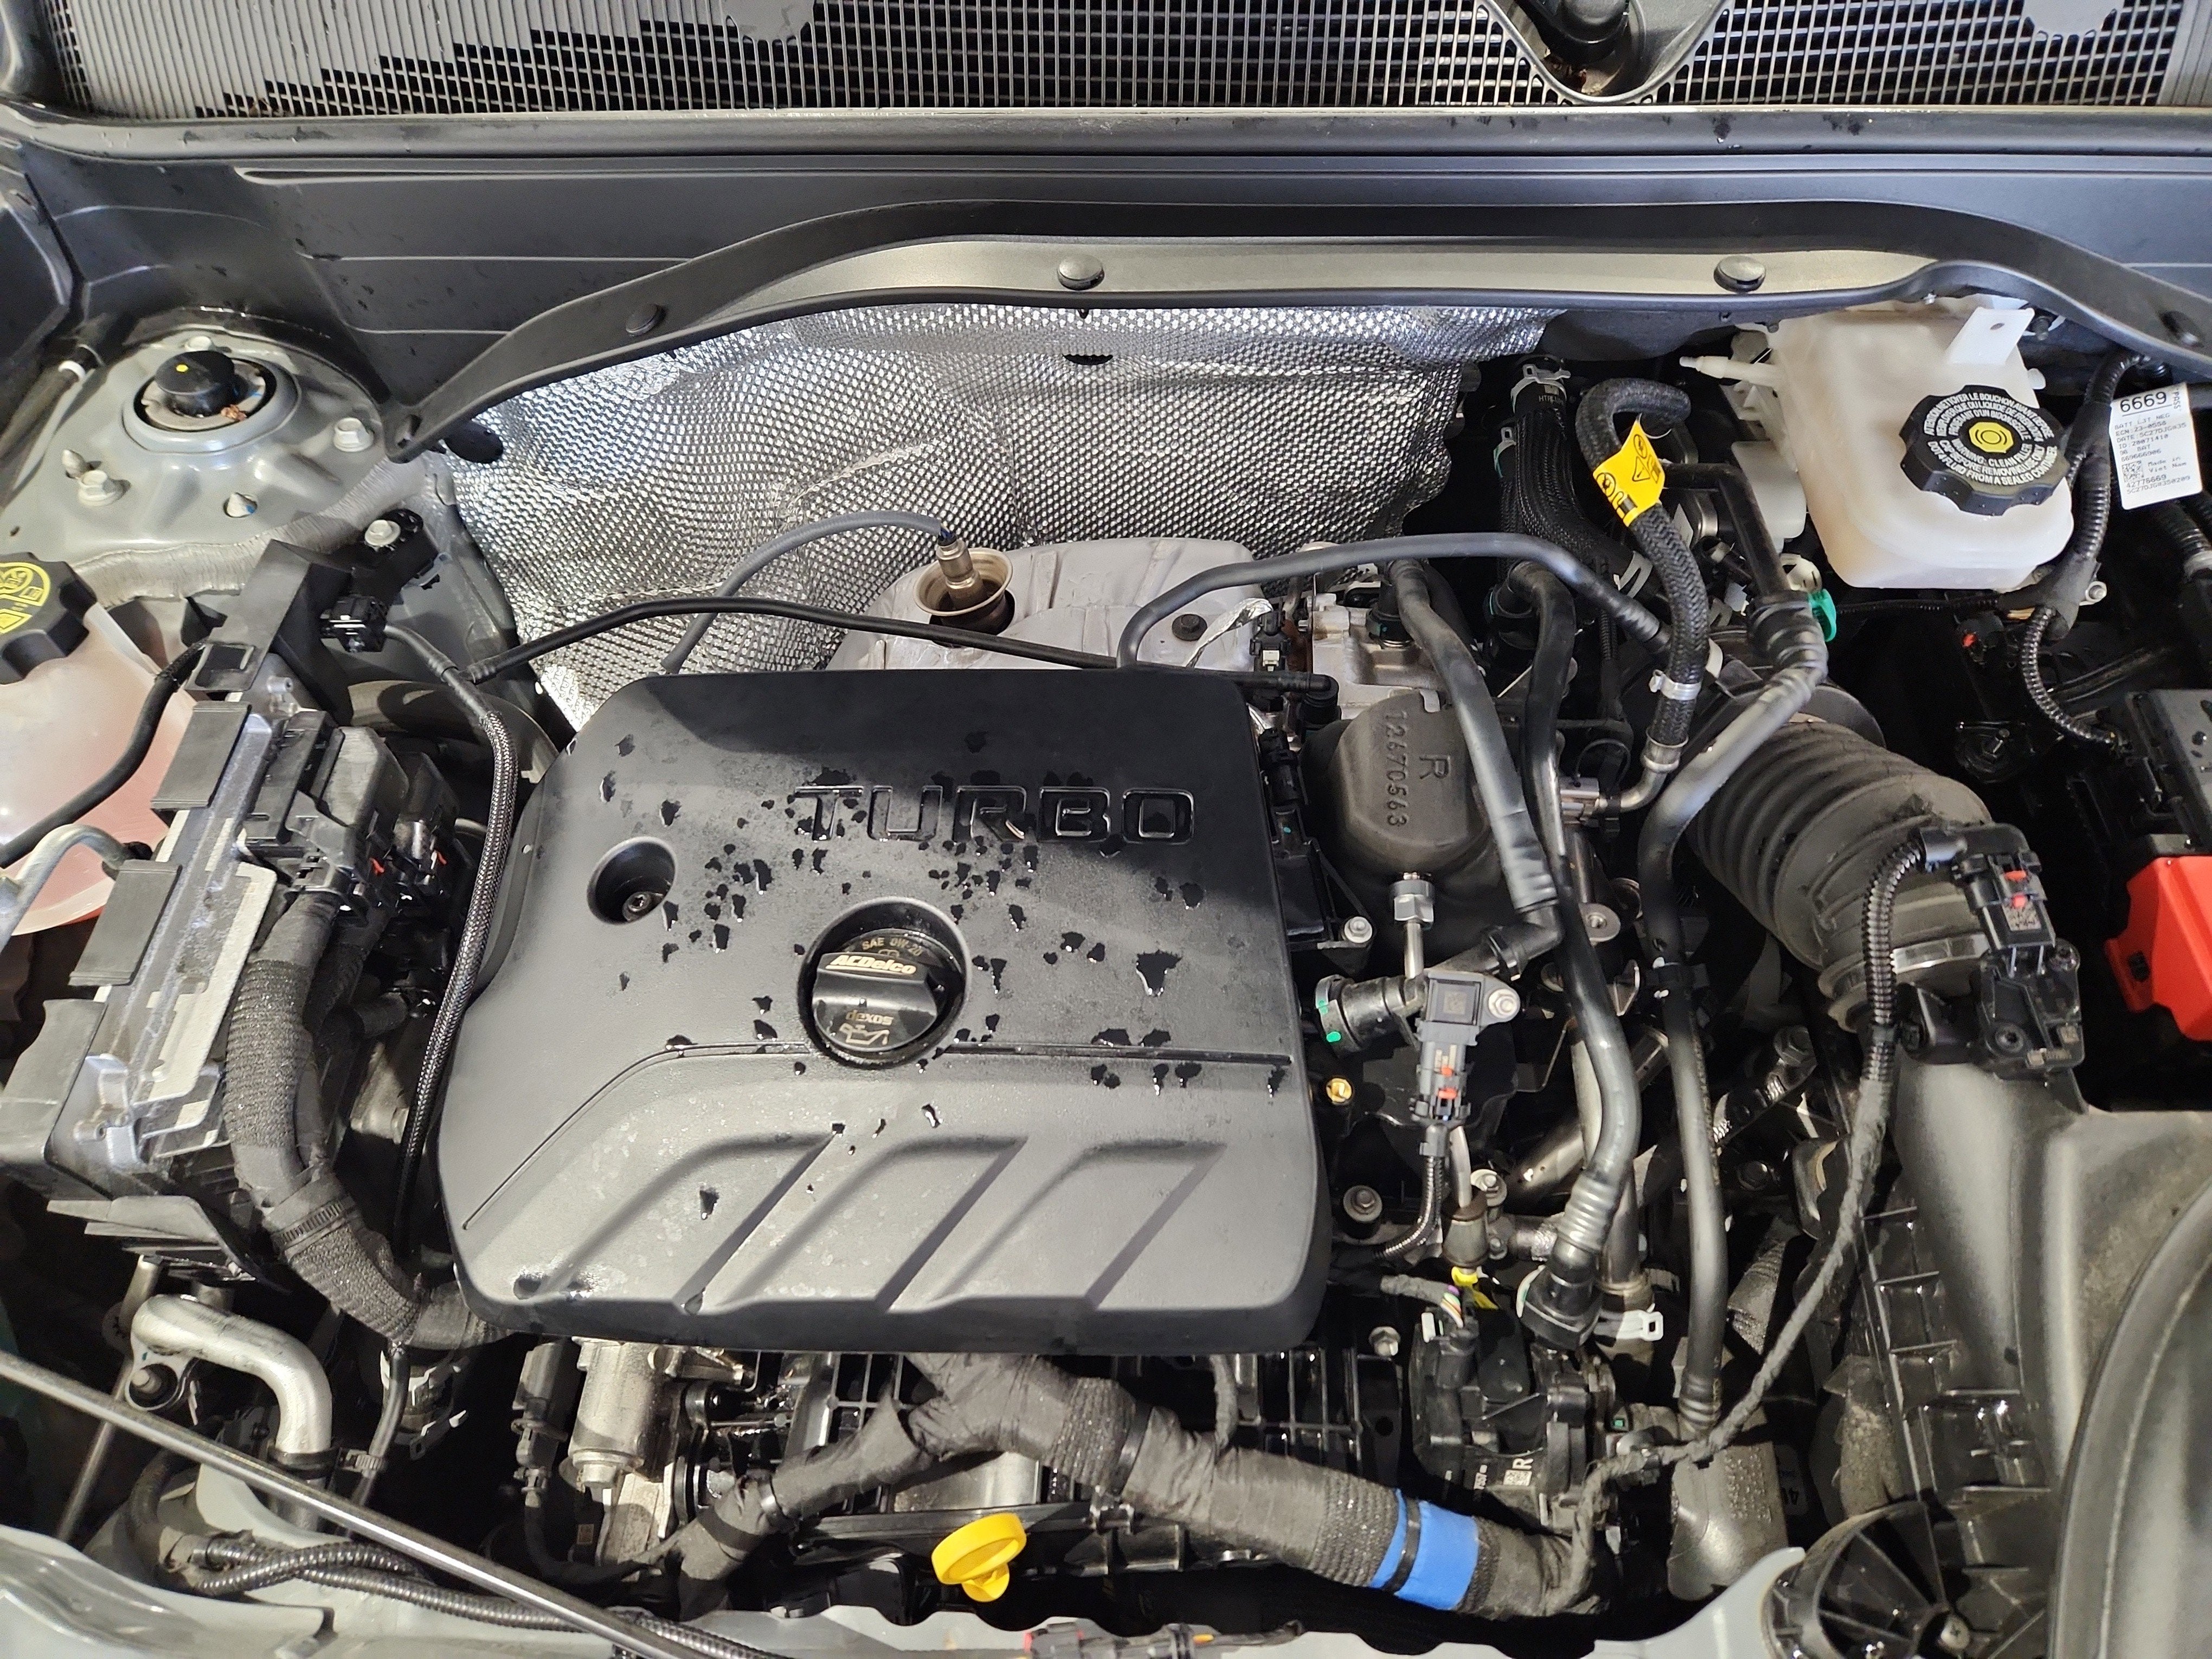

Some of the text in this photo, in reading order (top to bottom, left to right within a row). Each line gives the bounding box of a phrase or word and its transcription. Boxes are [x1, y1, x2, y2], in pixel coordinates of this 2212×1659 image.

[2005, 407, 2017, 416] DE
[2120, 391, 2167, 413] 6669
[1939, 440, 1955, 453] CAP
[1950, 451, 1983, 473] BEFORE
[2030, 444, 2045, 461] ONLY
[1987, 457, 2017, 467] CLEAN
[2014, 443, 2033, 463] FILLER
[1942, 456, 1968, 475] FLUID
[1966, 470, 1993, 484] FROM
[1994, 476, 2001, 485] A
[2001, 472, 2034, 485] SEALED
[2126, 473, 2166, 488] 42776669
[1383, 710, 1410, 827] 12670563
[1419, 754, 1452, 779] R
[793, 785, 1194, 844] TURBO
[861, 937, 885, 950] SAE
[830, 954, 917, 975] ACDelco
[845, 1009, 894, 1026] dexos
